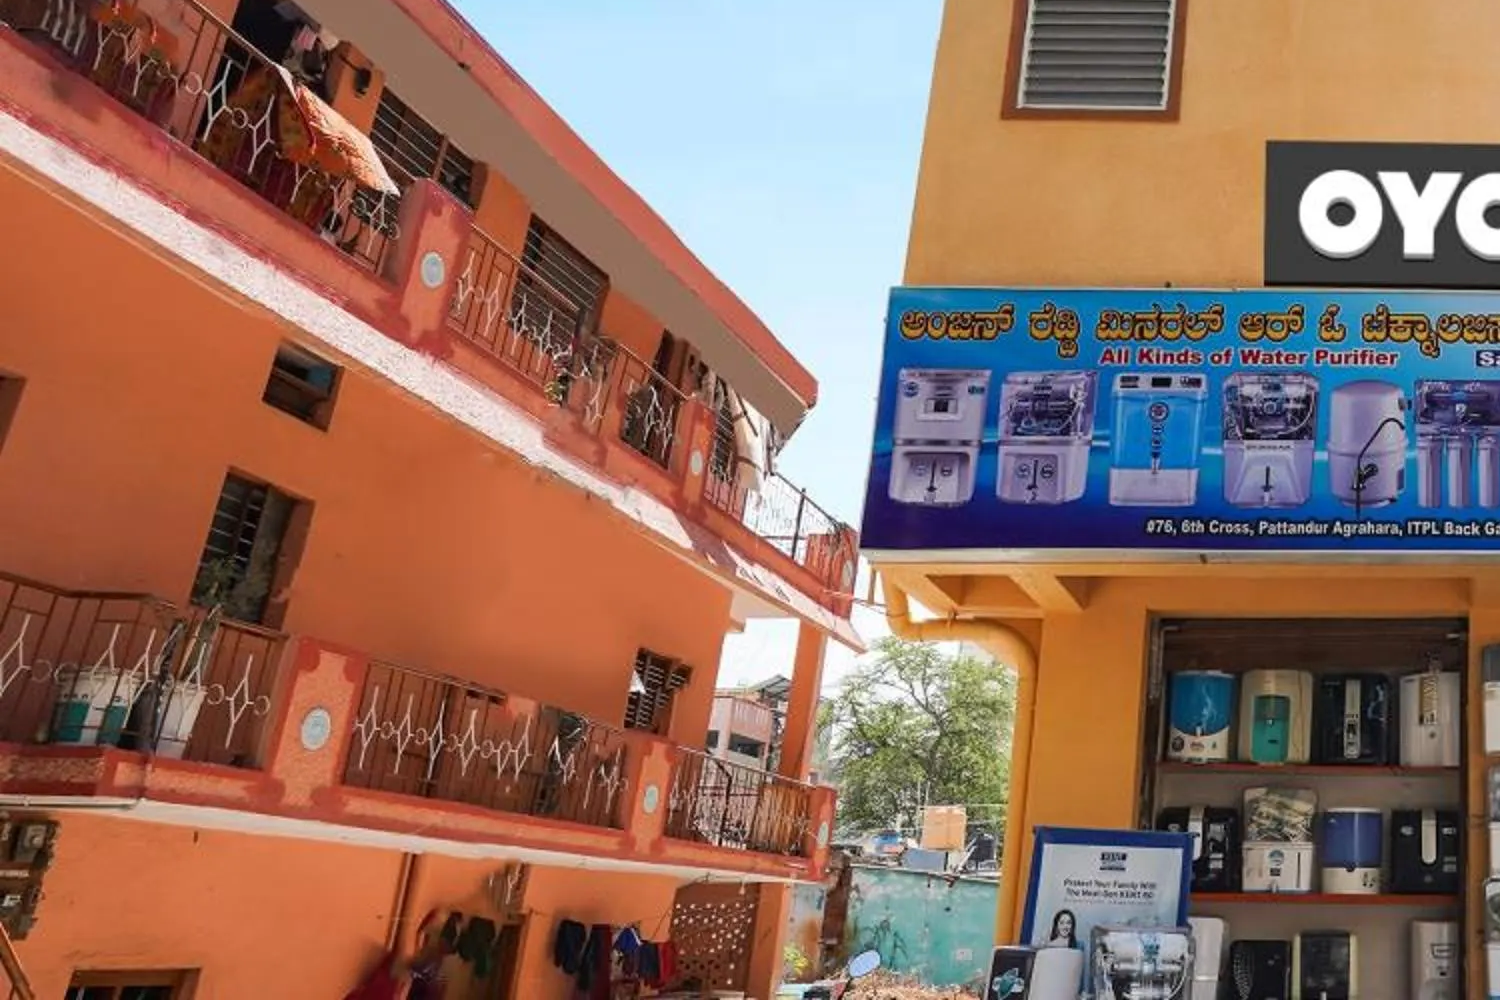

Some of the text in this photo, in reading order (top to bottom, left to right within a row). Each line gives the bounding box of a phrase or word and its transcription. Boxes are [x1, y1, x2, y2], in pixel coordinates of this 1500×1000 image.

[1100, 349, 1398, 365] All Kinds of Water Purifier
[1181, 520, 1205, 533] 6th
[1209, 520, 1254, 537] Cross,
[1259, 520, 1329, 535] Pattandur
[1333, 521, 1403, 538] Agrahara,
[1408, 521, 1440, 535] ITPL
[1444, 521, 1481, 535] Back
